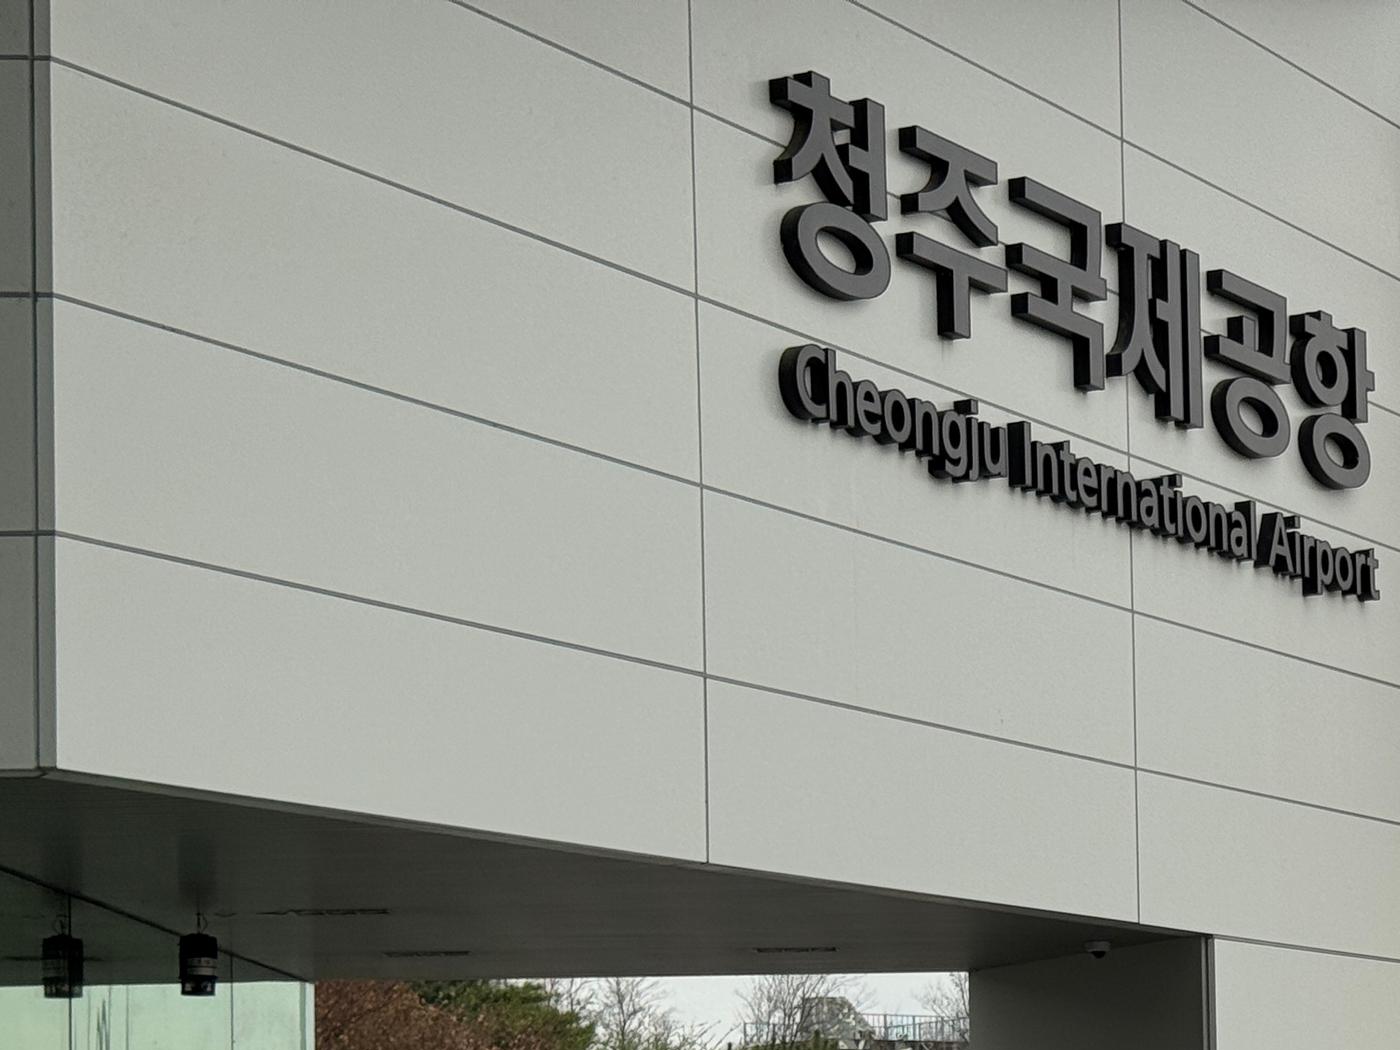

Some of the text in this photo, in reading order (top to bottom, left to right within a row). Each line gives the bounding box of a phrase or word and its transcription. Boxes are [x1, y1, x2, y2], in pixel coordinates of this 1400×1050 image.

[768, 70, 1376, 490] 청주국제공항
[778, 342, 1380, 601] Cheongju International Airport
